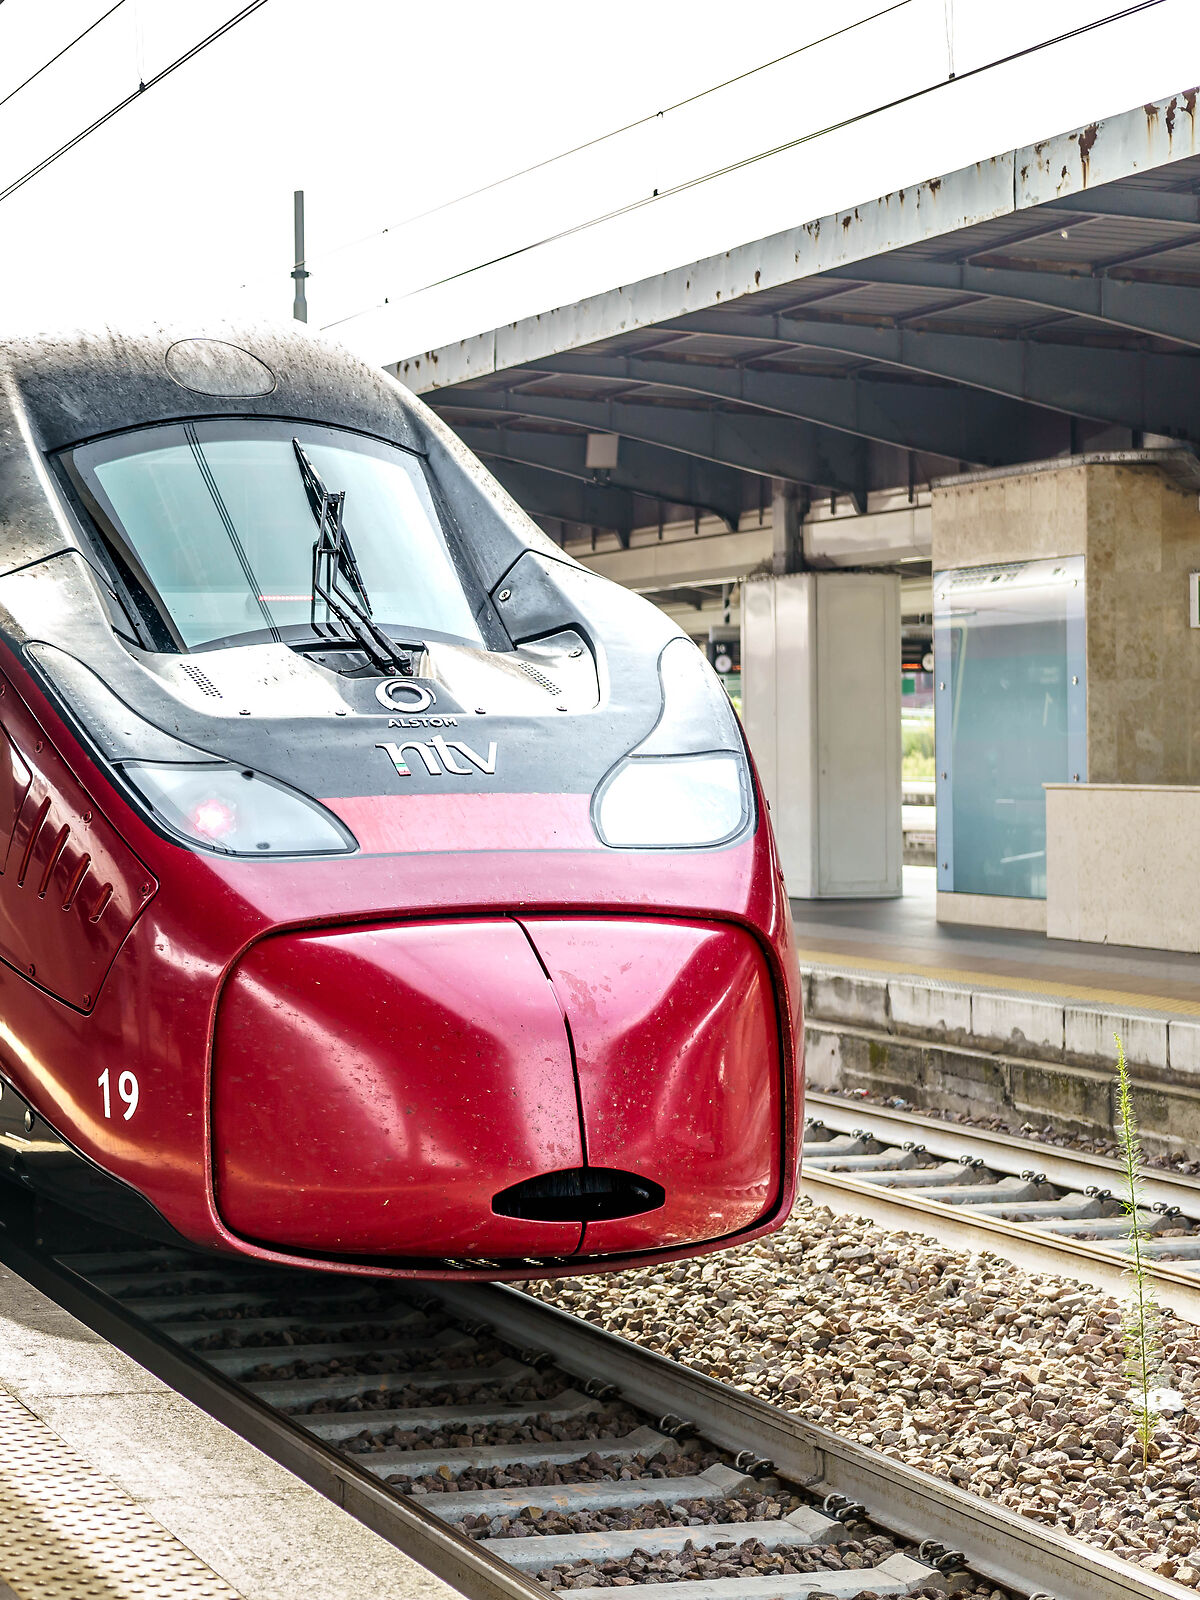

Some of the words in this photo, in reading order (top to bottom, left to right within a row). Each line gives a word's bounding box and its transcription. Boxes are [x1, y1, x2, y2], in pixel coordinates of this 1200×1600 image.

[388, 717, 458, 728] ALSTOM
[375, 734, 498, 776] ntv
[97, 1067, 139, 1121] 19
